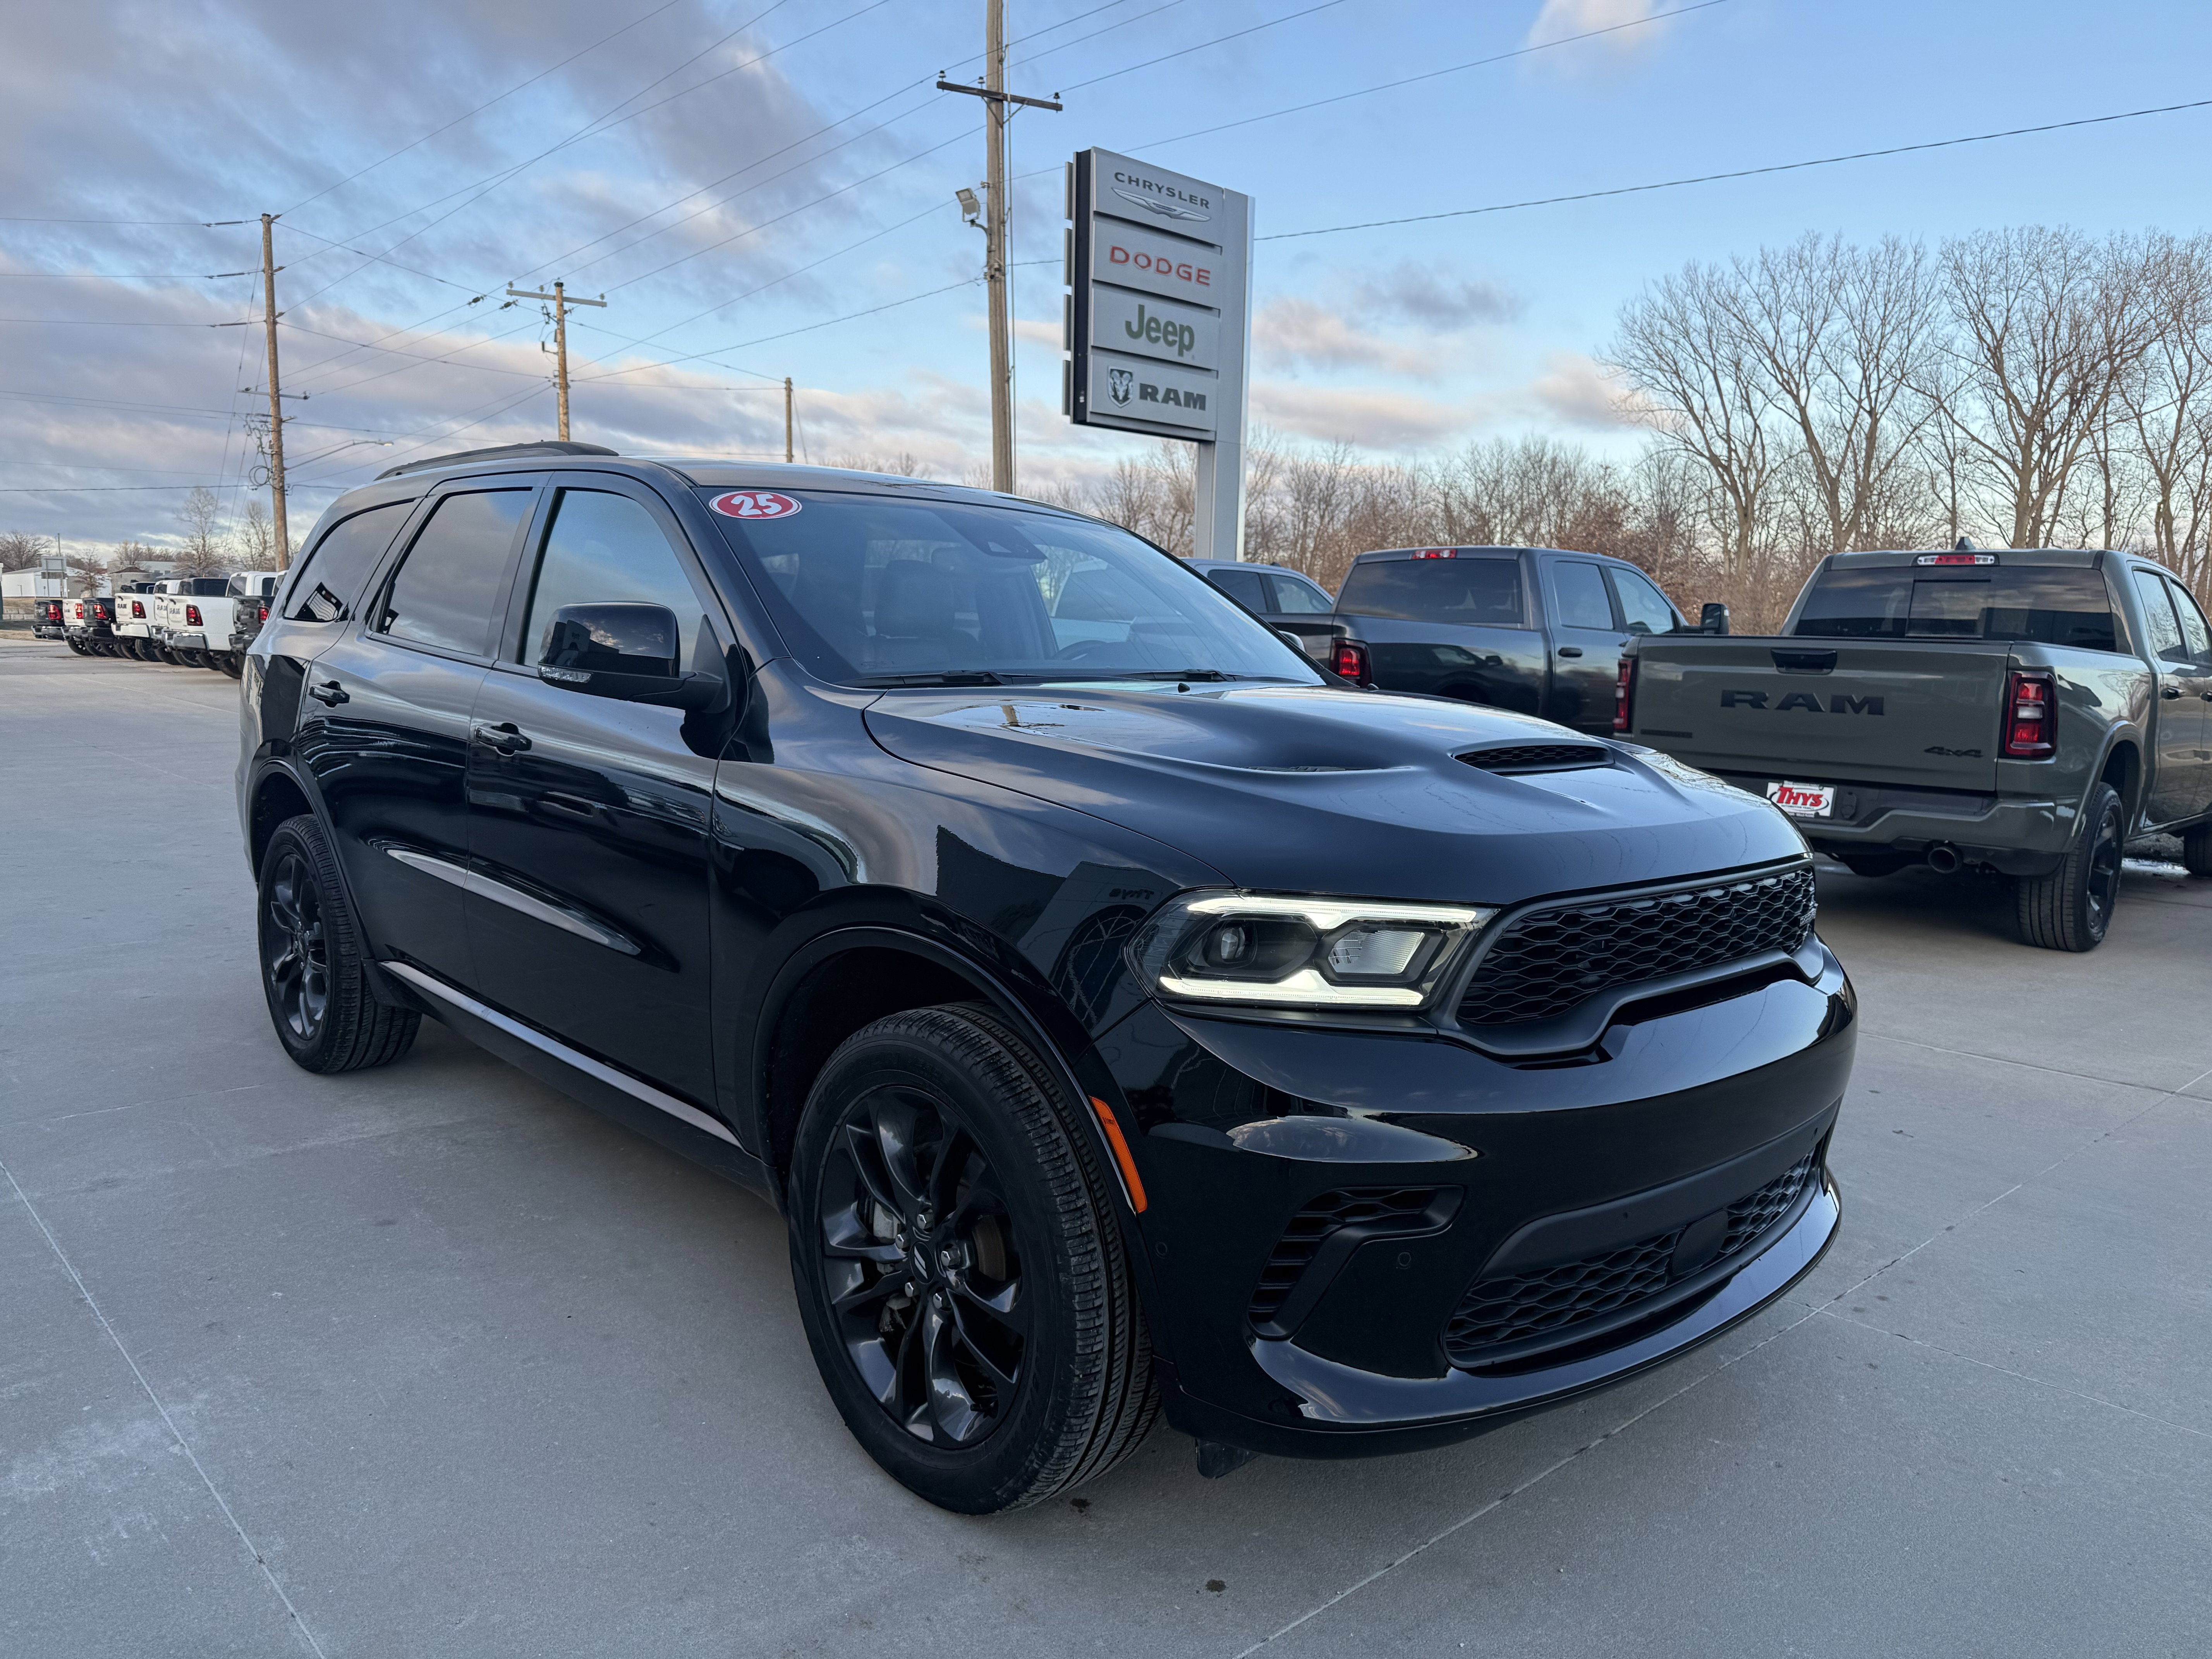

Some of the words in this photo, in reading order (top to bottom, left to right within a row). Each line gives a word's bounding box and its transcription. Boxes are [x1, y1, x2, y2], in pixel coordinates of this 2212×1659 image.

[1114, 172, 1210, 209] CHRYSLER
[1109, 246, 1211, 287] DODGE
[1125, 304, 1194, 357] Jeep
[1139, 383, 1206, 411] RAM
[731, 494, 782, 516] 25
[1720, 689, 1885, 716] RAM
